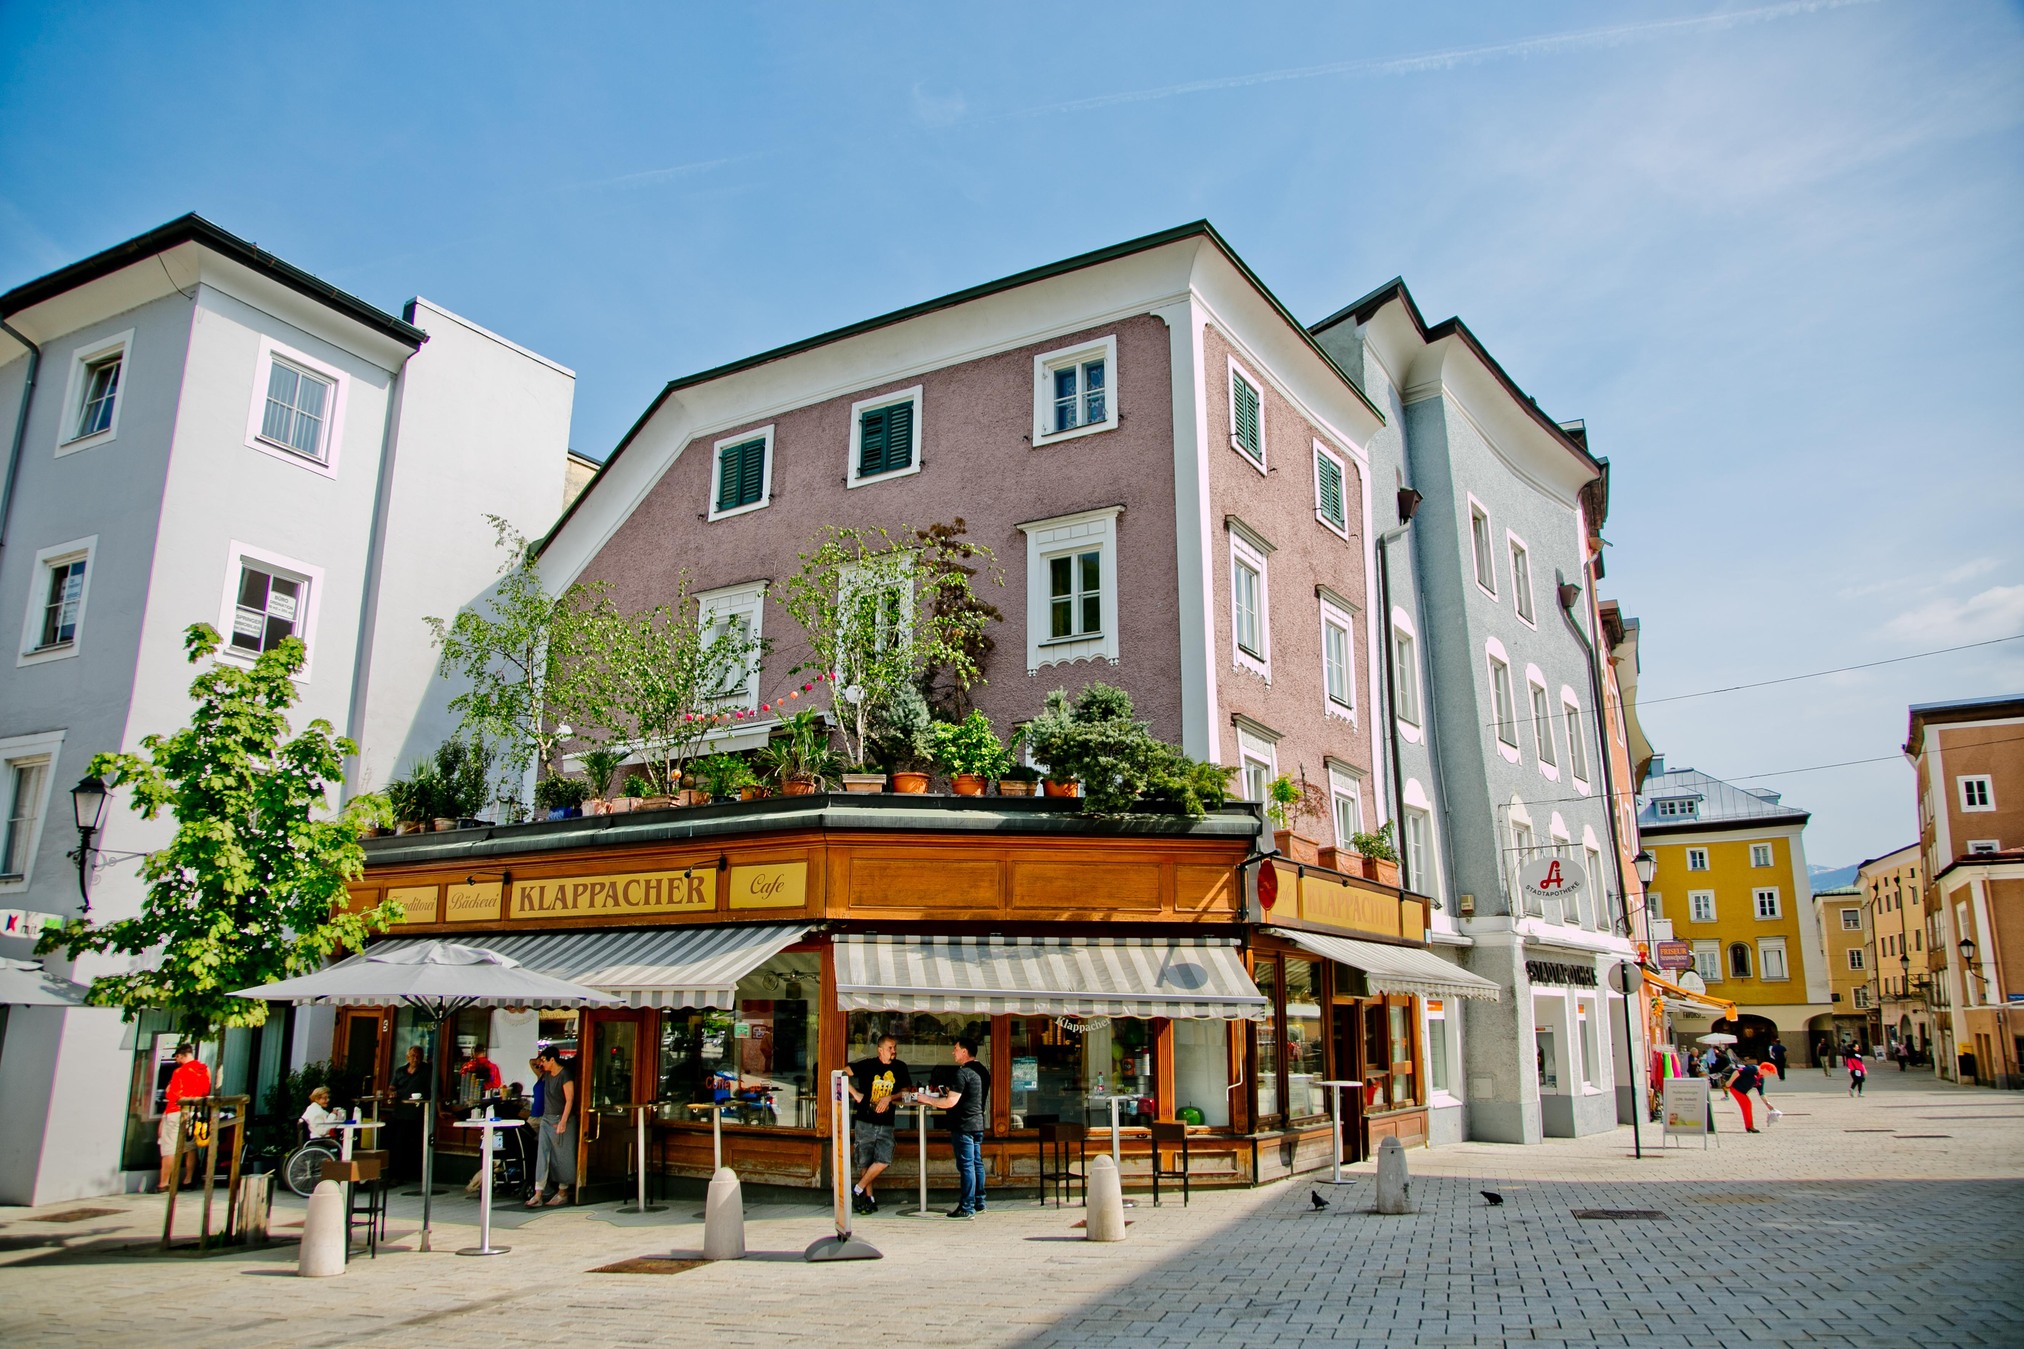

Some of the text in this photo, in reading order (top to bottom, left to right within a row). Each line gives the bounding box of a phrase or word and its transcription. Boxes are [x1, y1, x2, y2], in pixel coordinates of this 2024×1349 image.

[518, 876, 707, 912] KLAPPACHER
[750, 873, 785, 899] Cafe
[1525, 881, 1580, 897] STADTAPOTHEKE
[449, 892, 499, 910] Bäckerei
[1055, 1016, 1111, 1033] Klappacher
